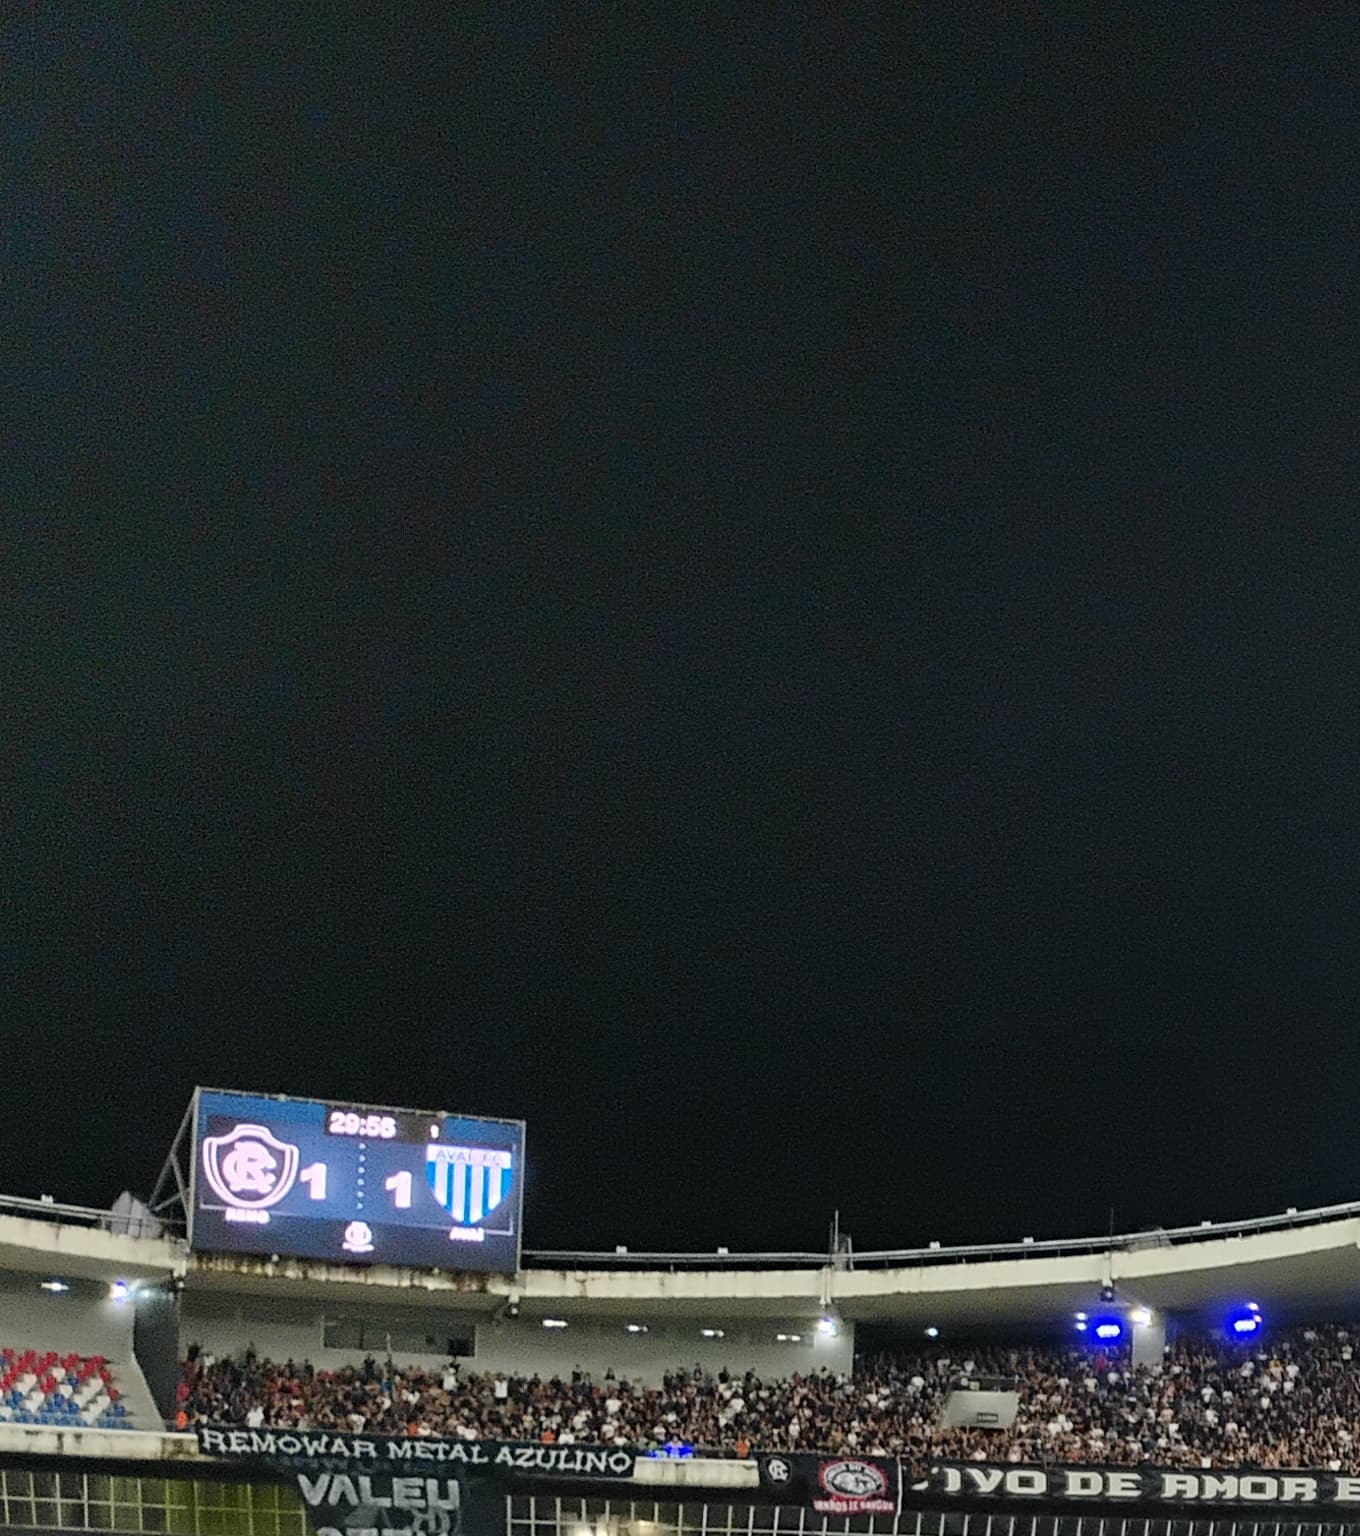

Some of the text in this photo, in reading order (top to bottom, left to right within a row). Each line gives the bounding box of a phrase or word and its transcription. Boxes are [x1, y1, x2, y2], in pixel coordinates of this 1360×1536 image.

[301, 1163, 327, 1200] 1
[385, 1171, 412, 1208] 1
[202, 1429, 378, 1458] REMOWAR
[388, 1441, 489, 1464] METAL
[498, 1449, 632, 1475] AZULINO
[297, 1474, 460, 1510] VALEU
[903, 1465, 1047, 1497] IVO
[1064, 1470, 1143, 1498] DE
[1161, 1474, 1318, 1501] AMOR
